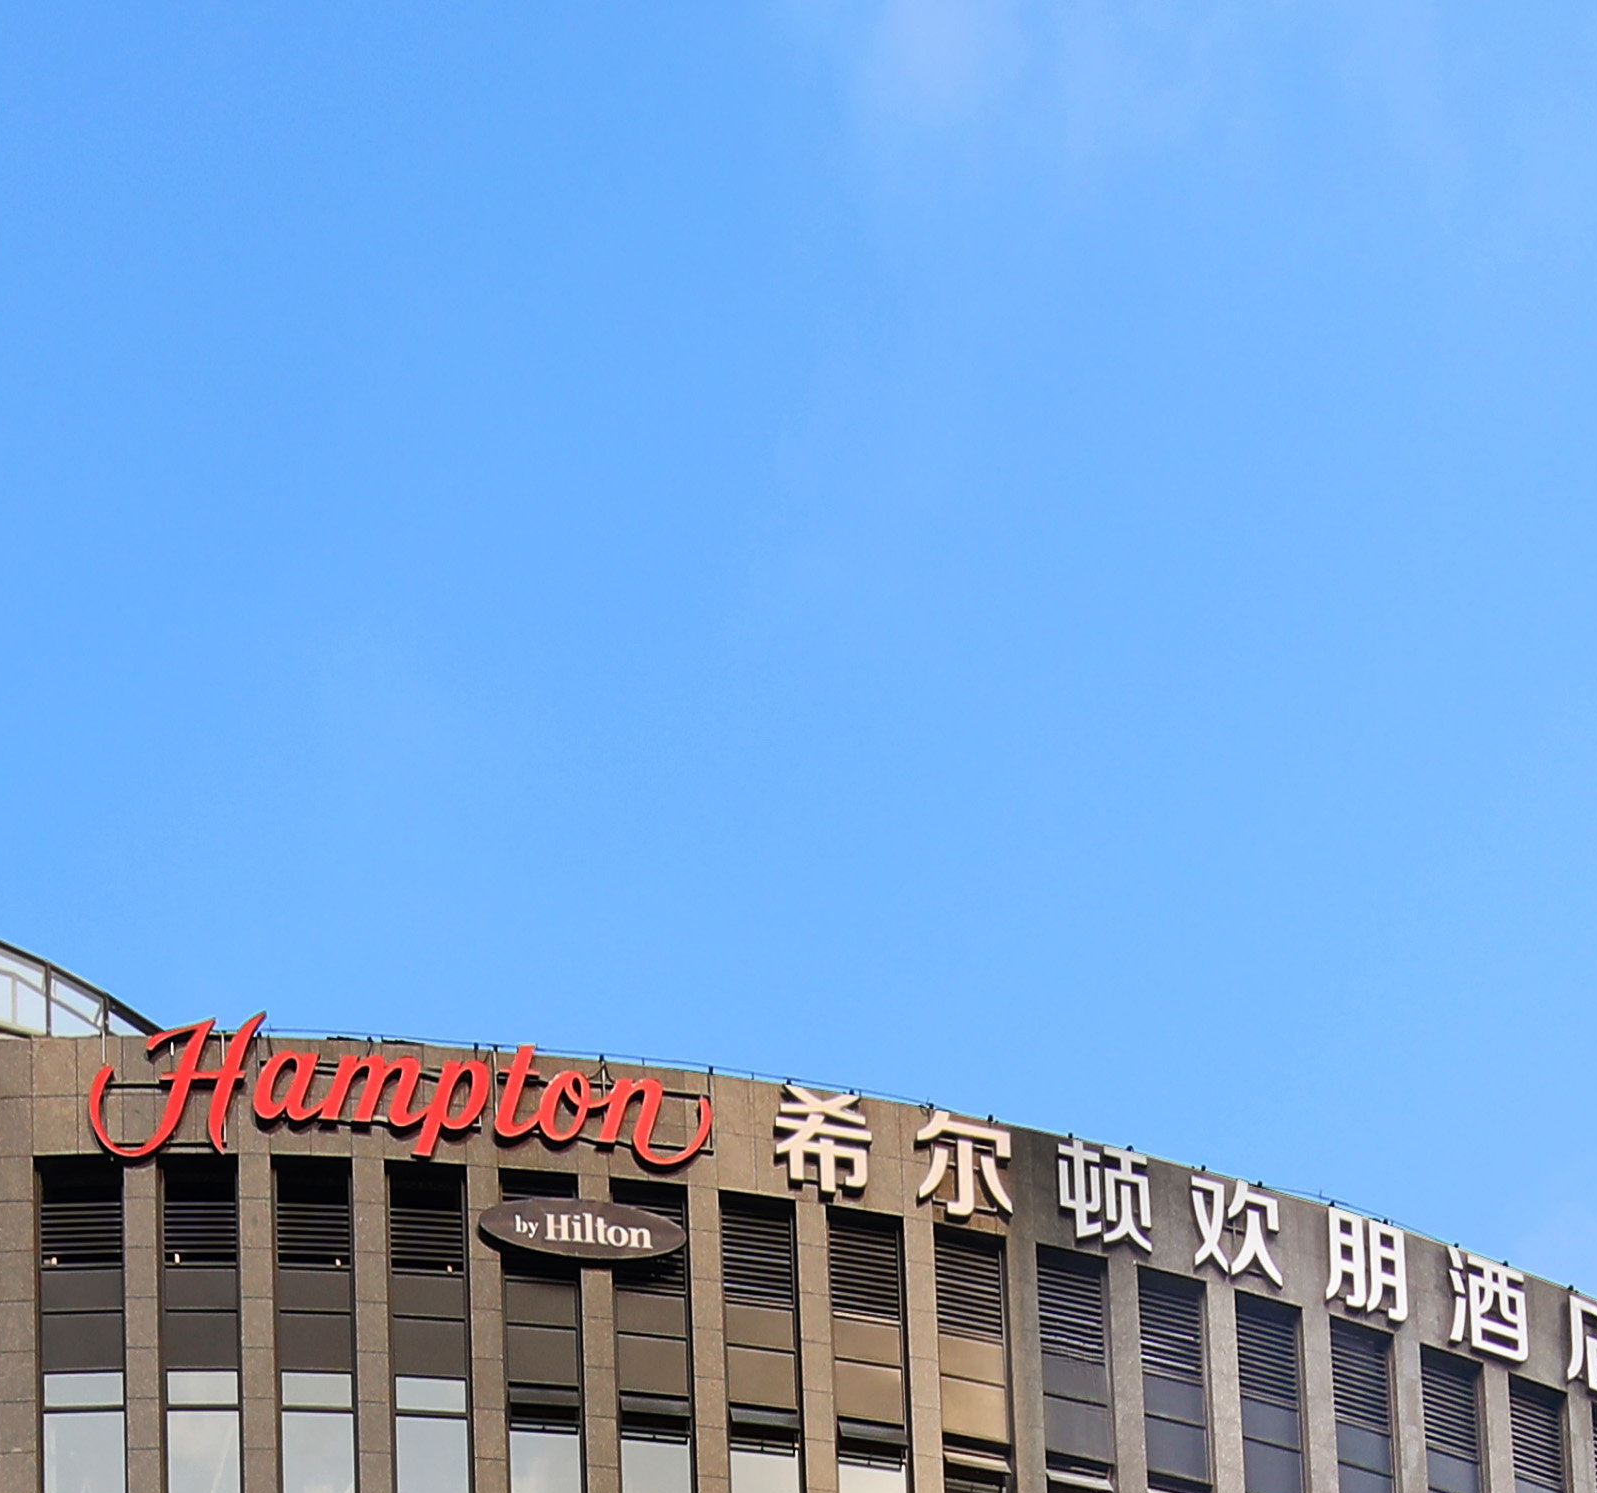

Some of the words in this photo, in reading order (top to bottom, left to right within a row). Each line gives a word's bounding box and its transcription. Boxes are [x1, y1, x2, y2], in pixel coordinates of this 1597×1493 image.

[89, 1011, 711, 1170] Hampton
[514, 1214, 539, 1240] by
[543, 1212, 653, 1250] Hilton
